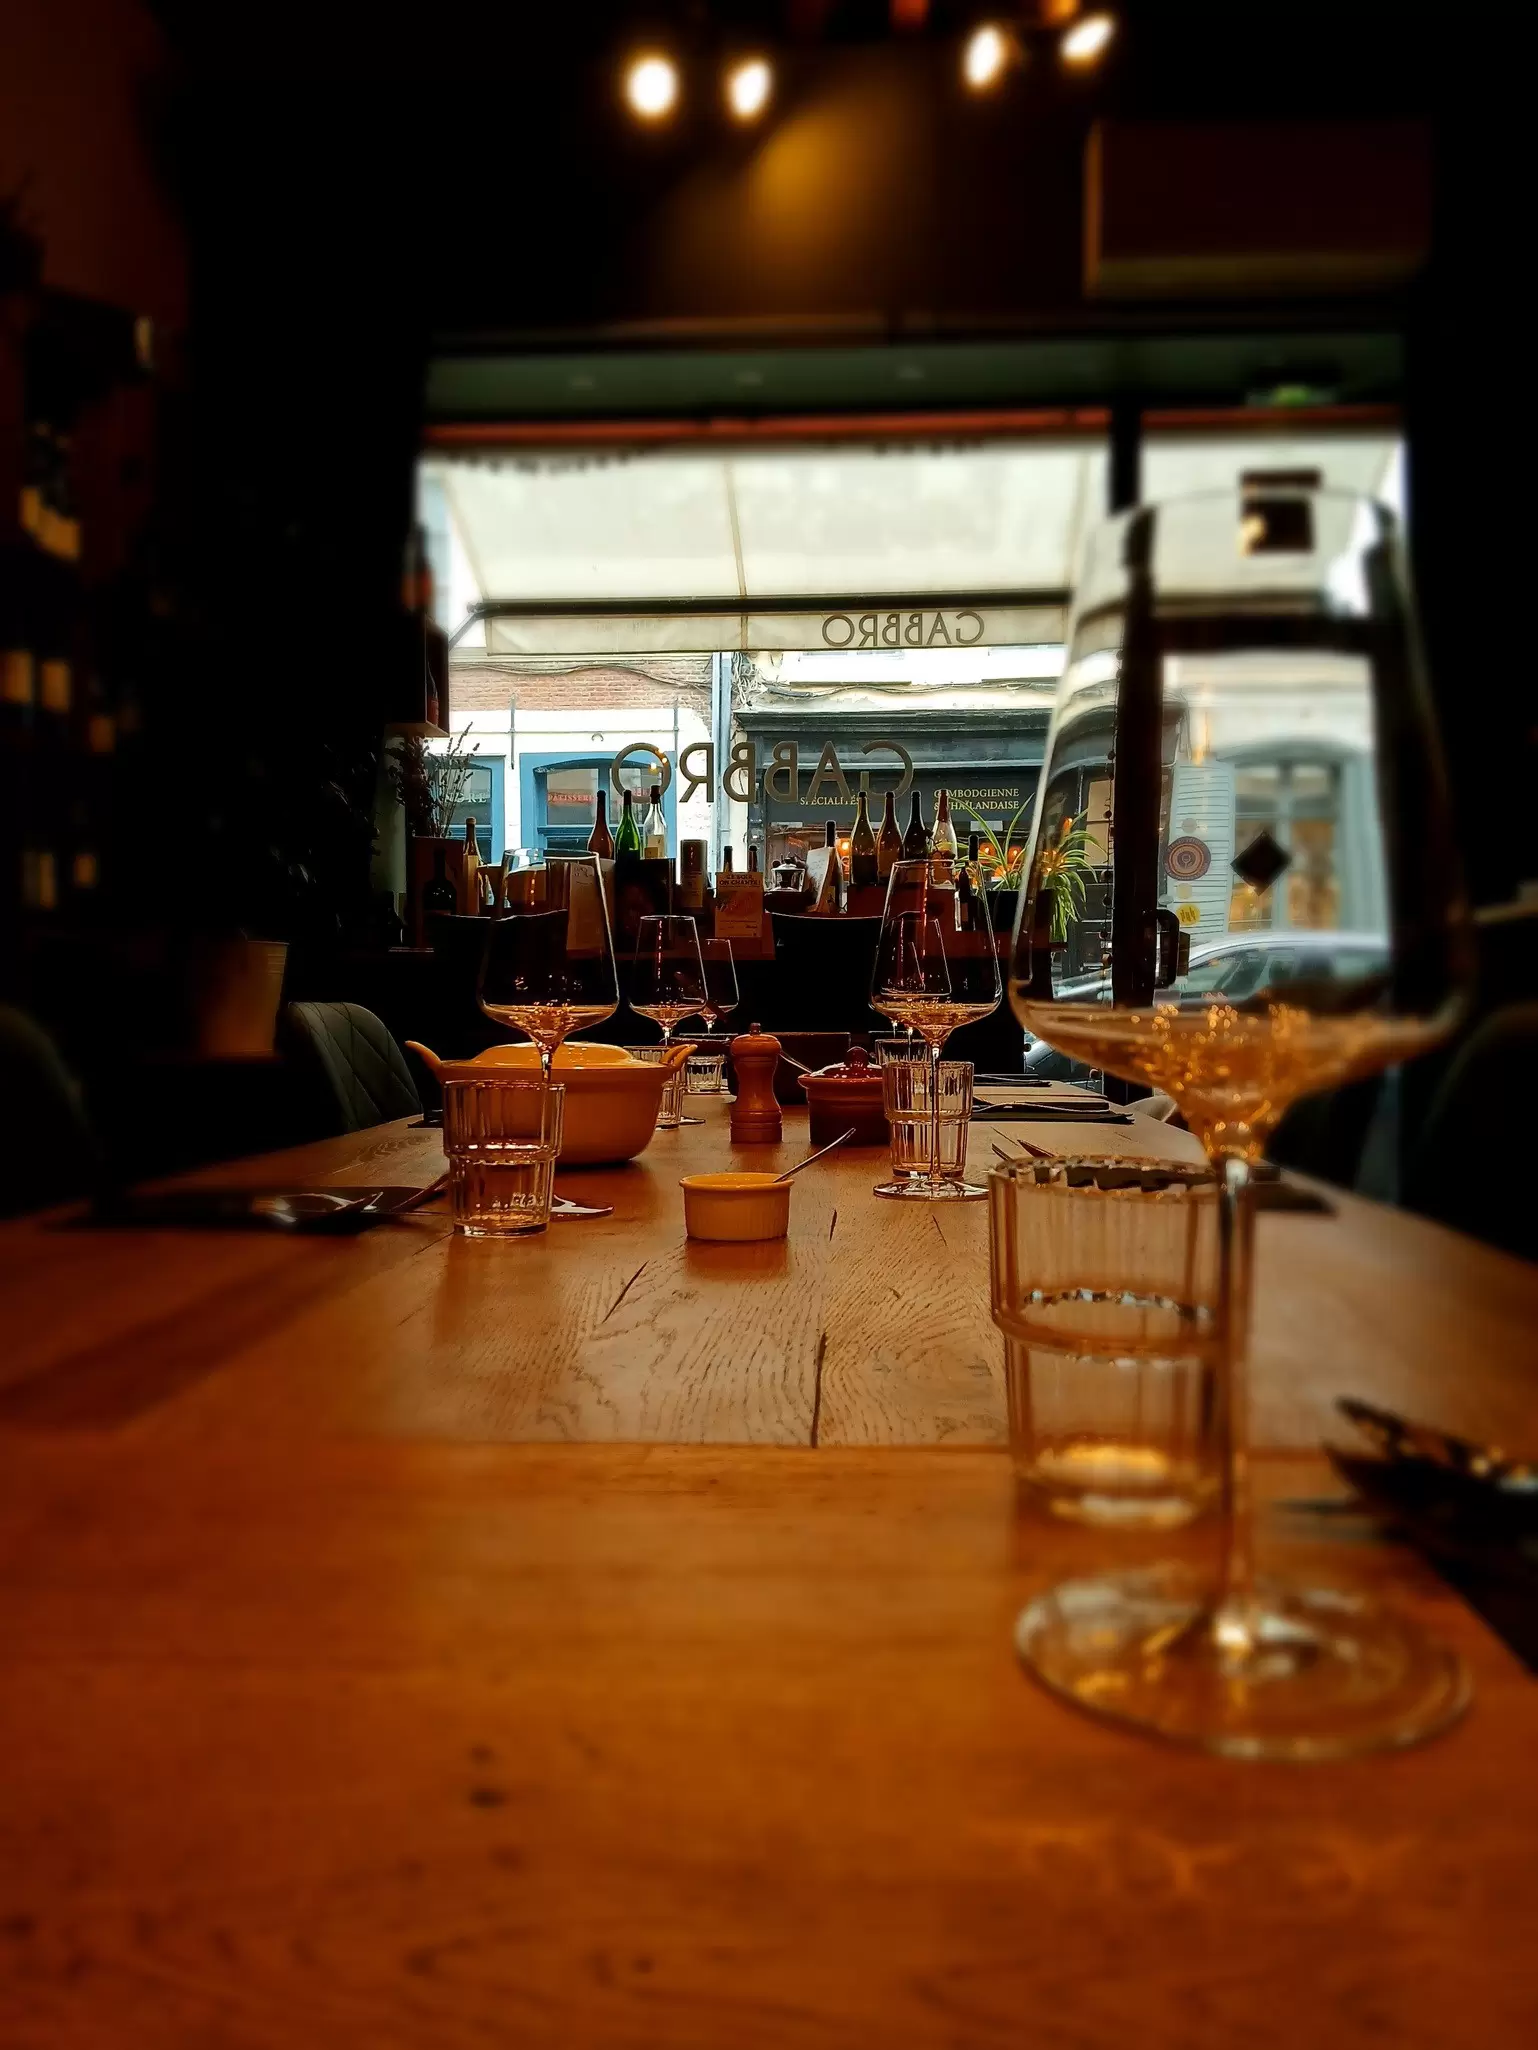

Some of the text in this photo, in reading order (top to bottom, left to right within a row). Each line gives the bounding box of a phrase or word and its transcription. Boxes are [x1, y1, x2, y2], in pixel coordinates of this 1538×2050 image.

[933, 788, 1020, 798] CMBODGIENNE
[800, 795, 859, 806] SÉCIALIÉ
[947, 800, 1020, 810] HALANDAISE
